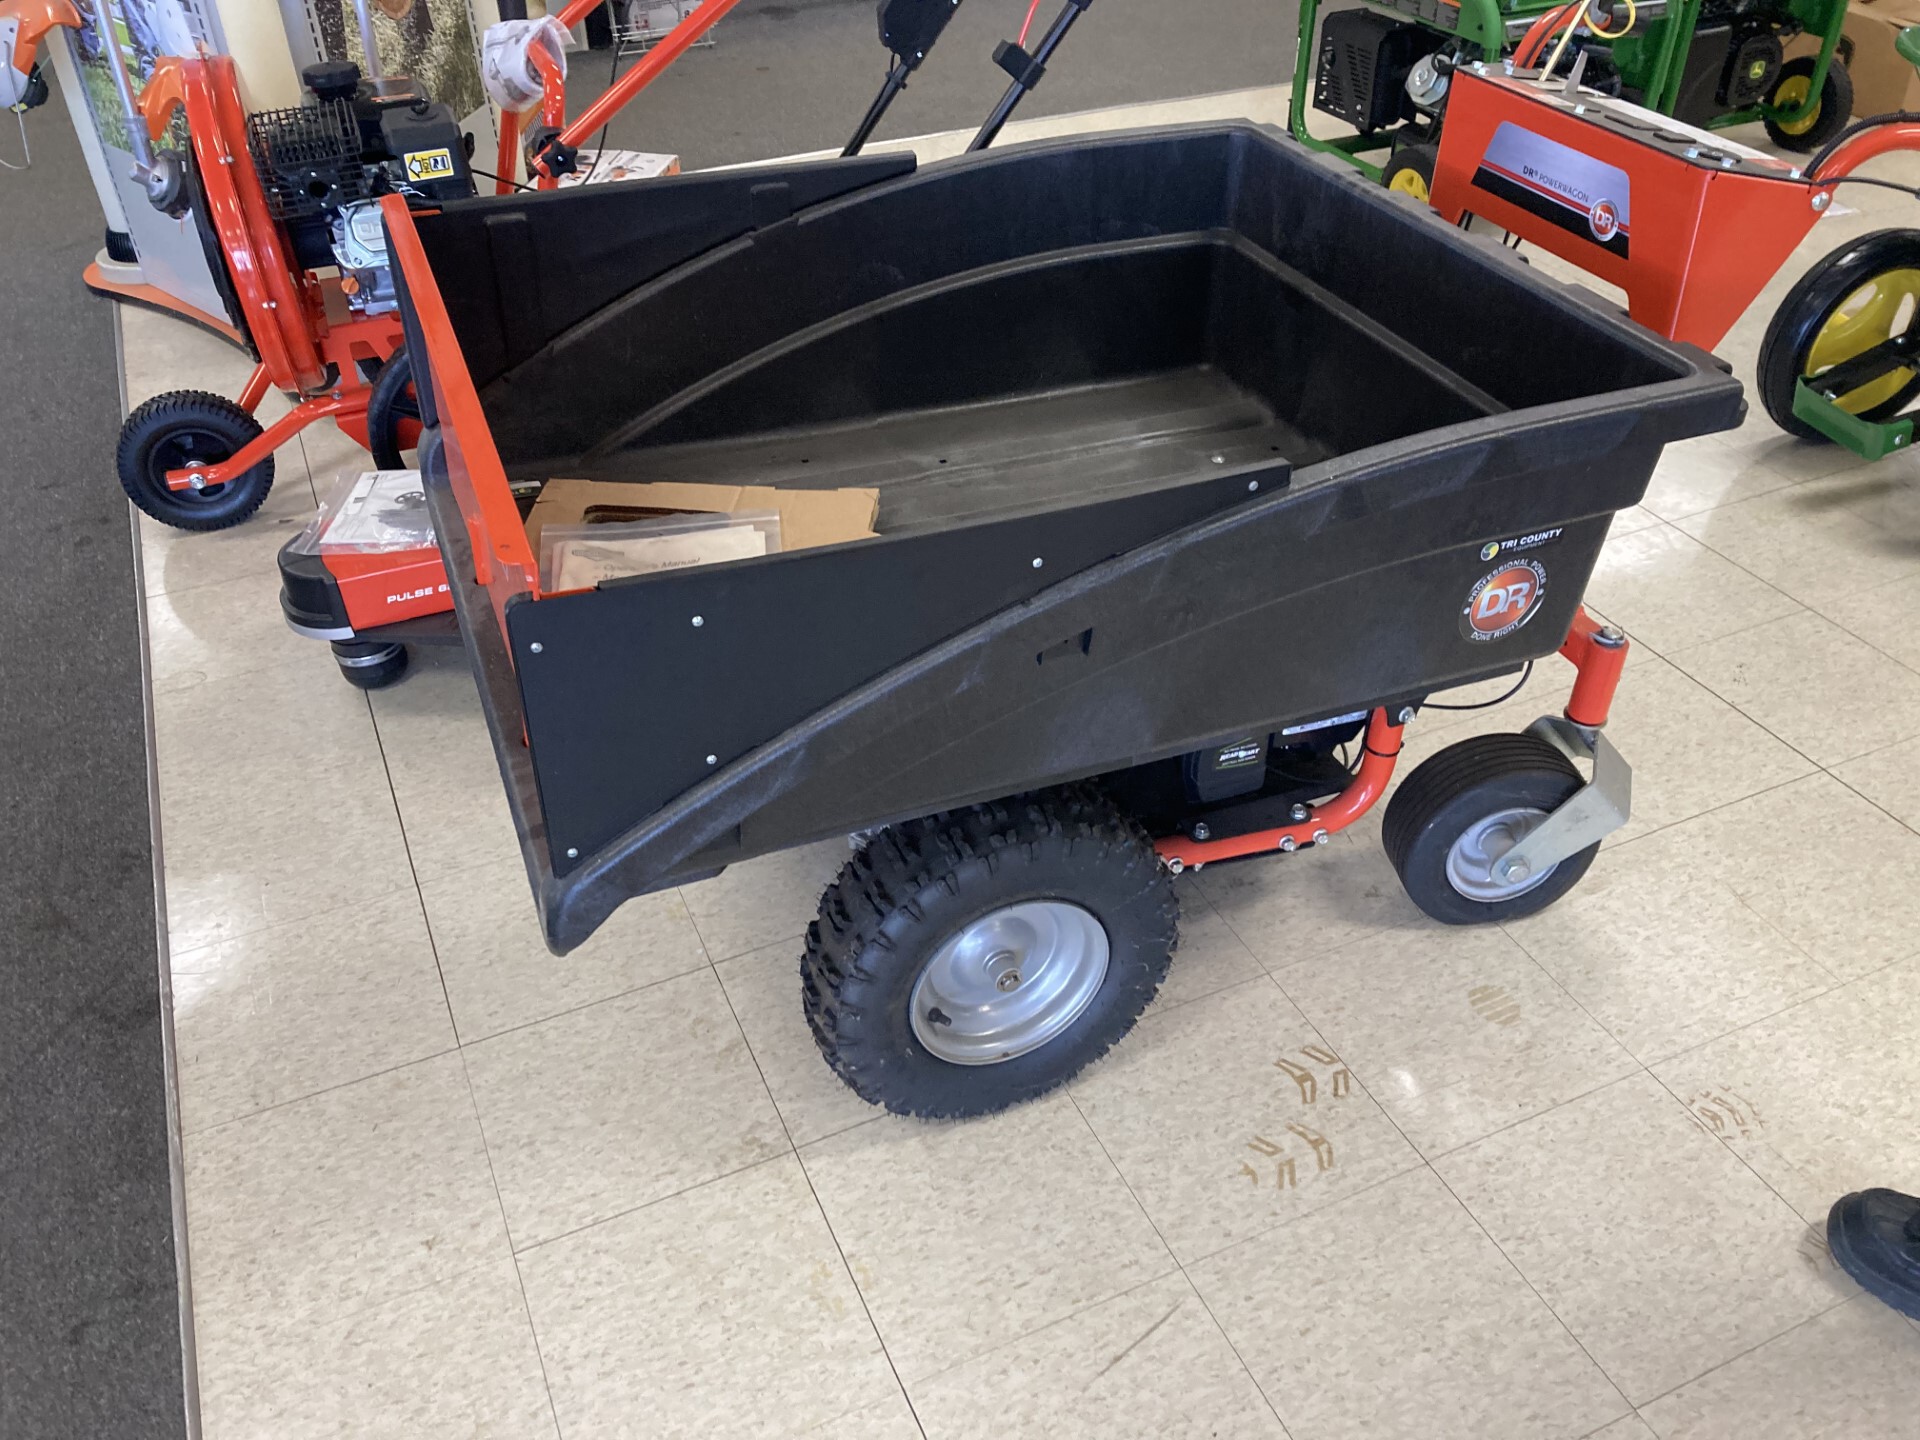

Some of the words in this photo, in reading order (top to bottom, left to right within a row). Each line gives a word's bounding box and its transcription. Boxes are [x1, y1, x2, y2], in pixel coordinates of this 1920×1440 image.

[421, 157, 431, 173] HOT
[1539, 173, 1589, 203] POWERWAGON
[1594, 209, 1613, 231] DR
[1501, 539, 1518, 550] TRI
[1520, 528, 1563, 545] COUNTY
[1468, 559, 1529, 603] PROFESSIONAL
[1531, 560, 1547, 585] POWER
[387, 586, 434, 604] PULSE
[1476, 582, 1530, 620] DR
[1471, 630, 1493, 641] DONE
[1493, 621, 1520, 639] RIGHT
